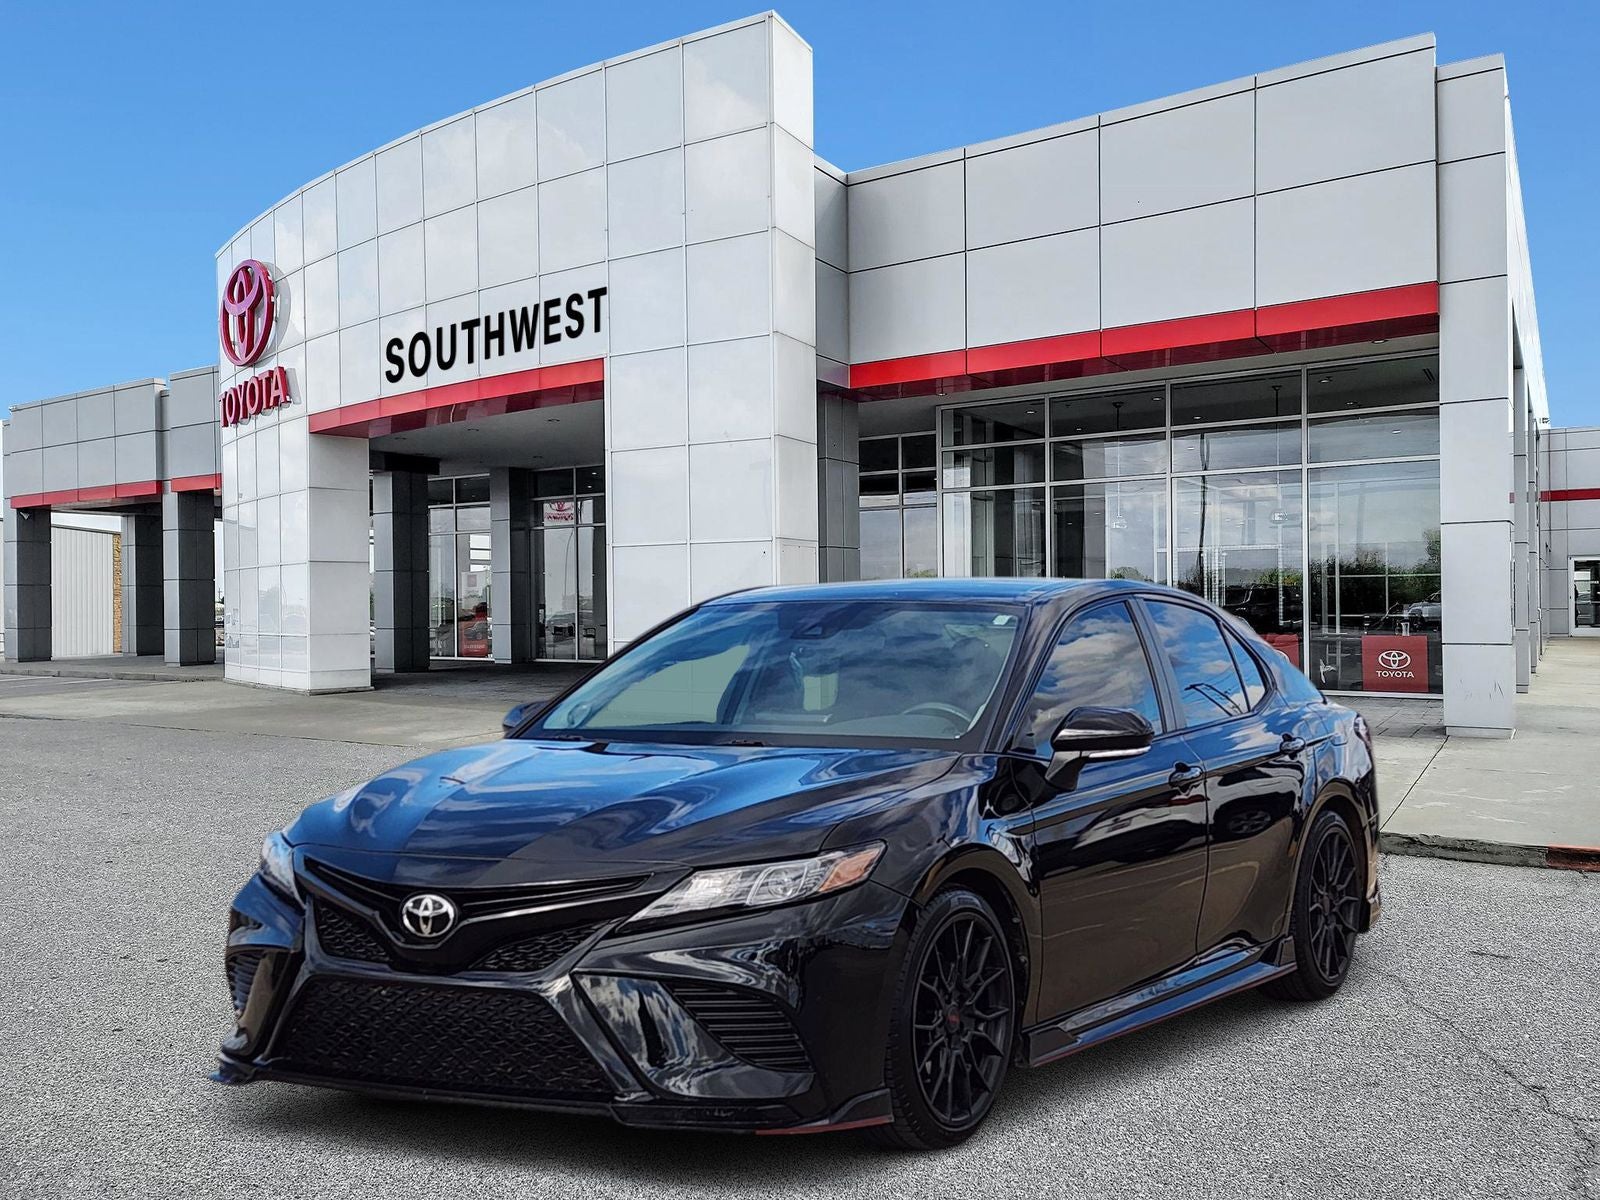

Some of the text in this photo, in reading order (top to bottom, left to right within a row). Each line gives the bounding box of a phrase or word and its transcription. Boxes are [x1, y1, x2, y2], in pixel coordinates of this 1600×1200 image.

[385, 286, 607, 383] SOUTHWEST
[219, 366, 289, 427] TOYOTA
[1375, 670, 1415, 678] TOYOTA
